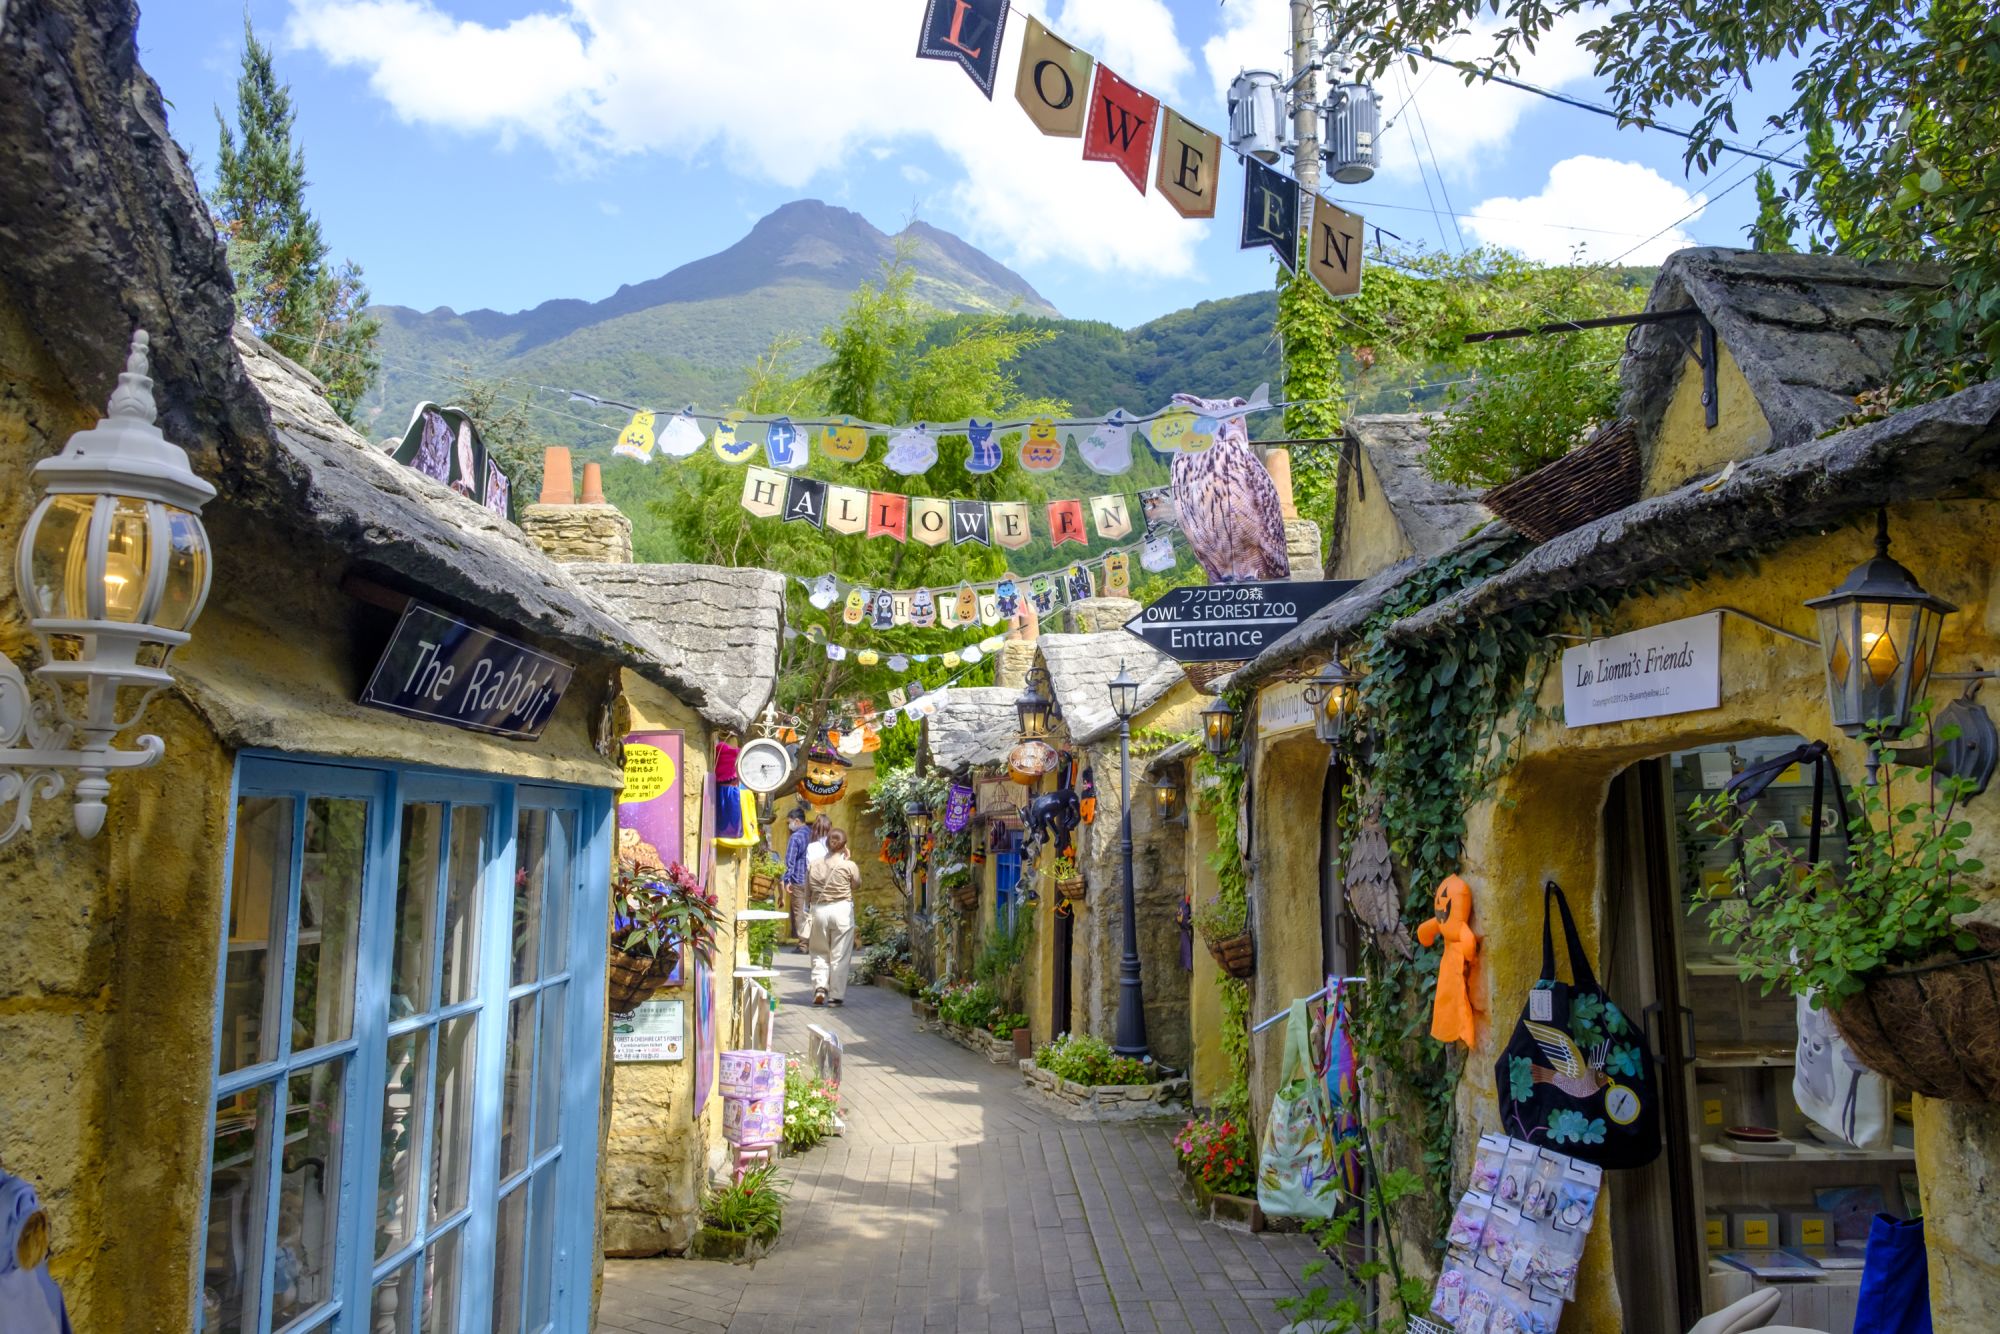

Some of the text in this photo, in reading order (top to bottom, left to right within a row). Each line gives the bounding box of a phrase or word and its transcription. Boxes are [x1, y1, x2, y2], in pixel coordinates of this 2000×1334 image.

[1180, 587, 1264, 603] フクロウの森
[1205, 603, 1258, 619] FOREST
[1263, 602, 1296, 617] ZOO
[1171, 628, 1263, 648] Entrance
[1576, 664, 1594, 687] Leo
[1644, 641, 1695, 673] Friends
[403, 640, 555, 730] The Rabbit
[806, 779, 839, 794] HALLOWEEN
